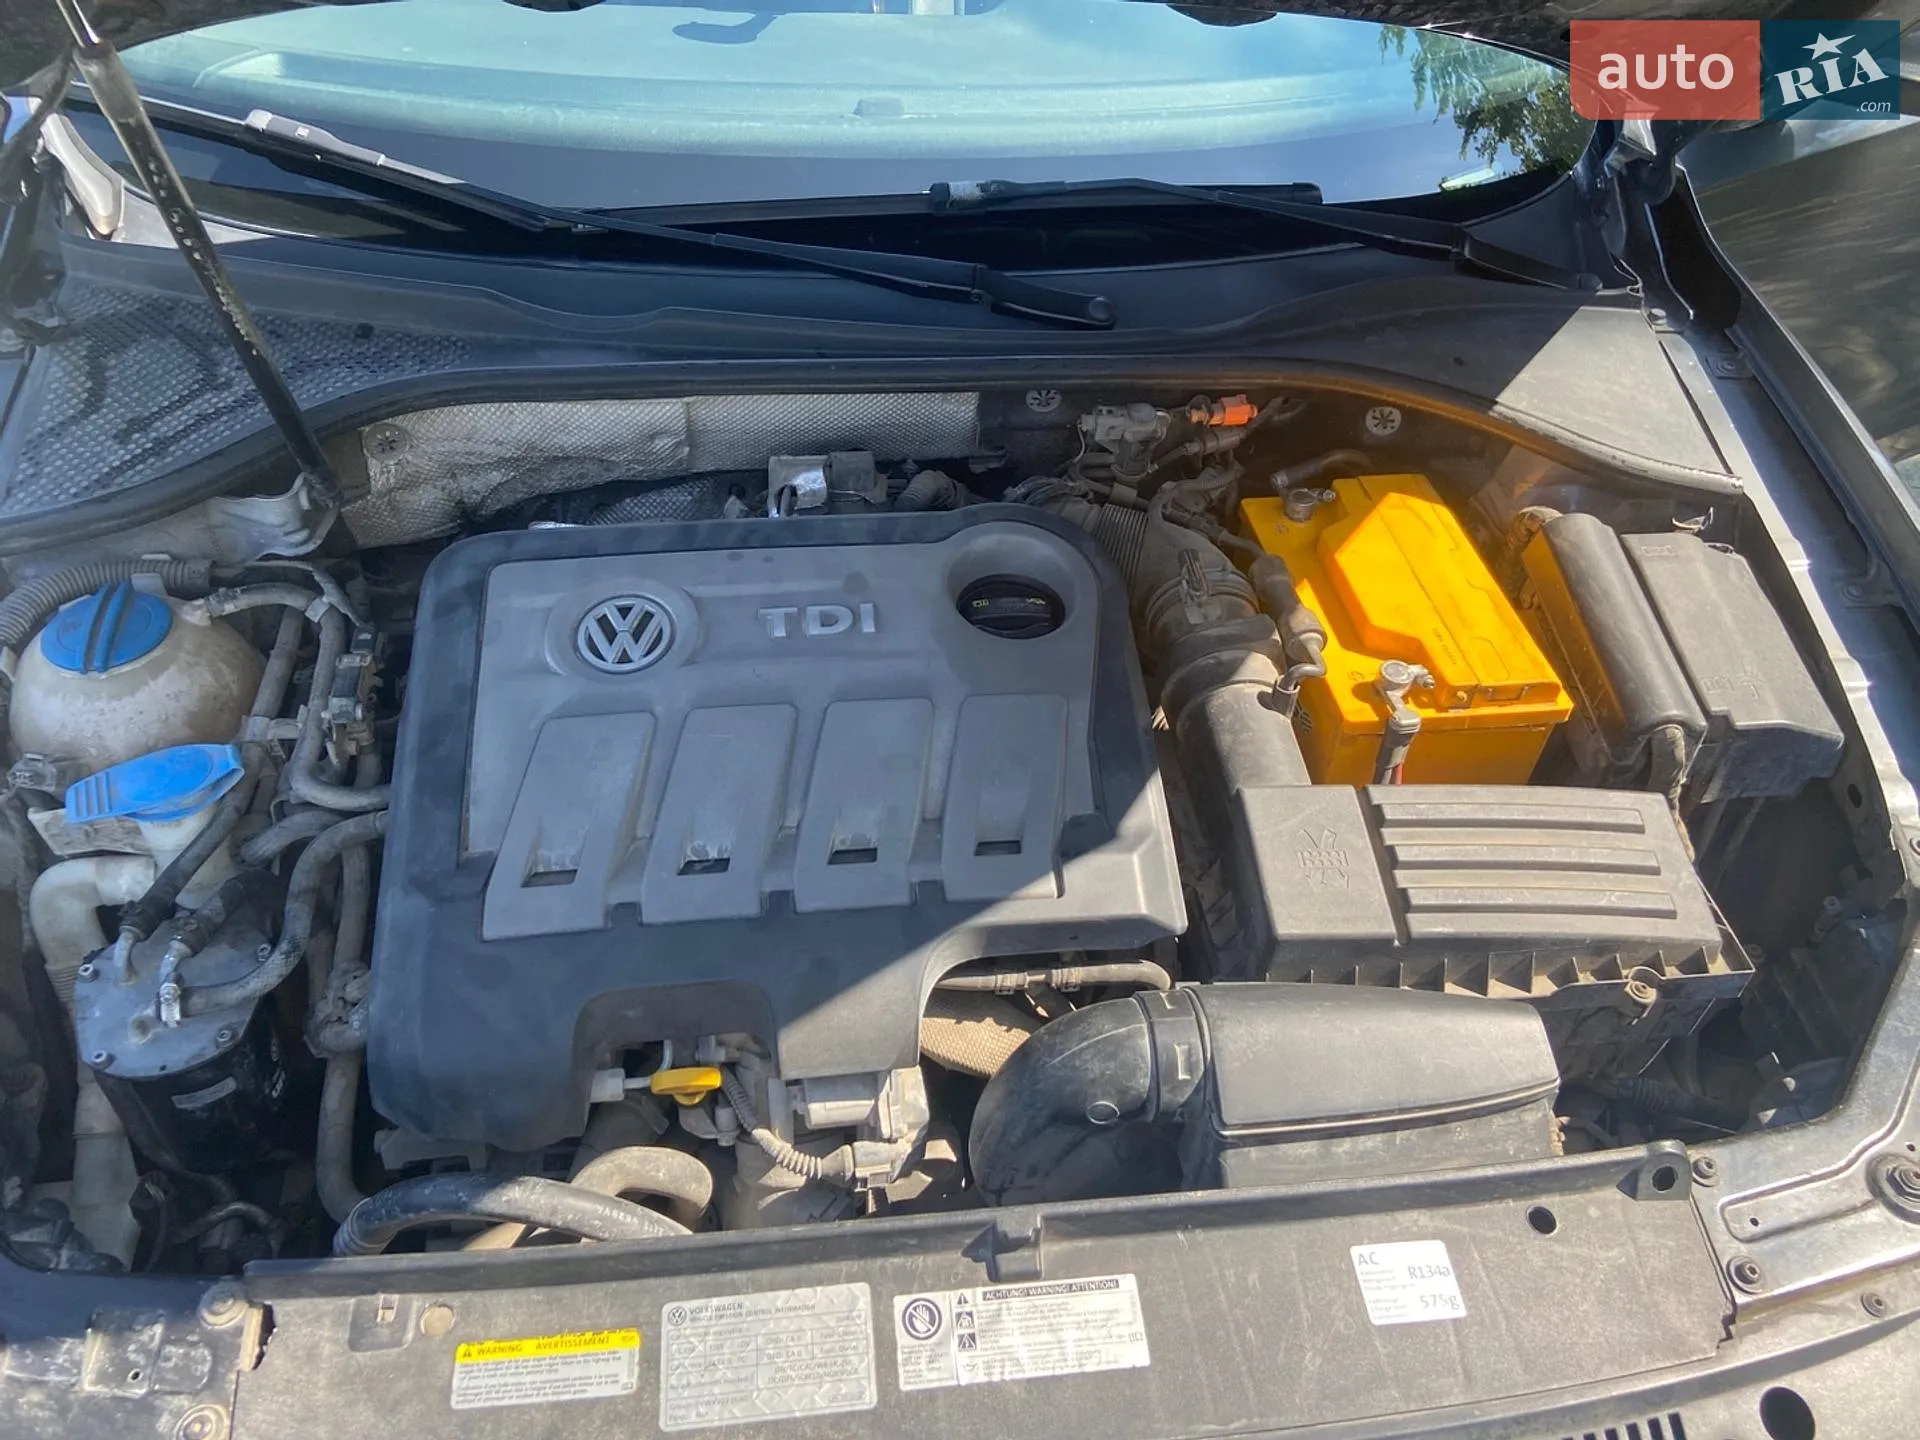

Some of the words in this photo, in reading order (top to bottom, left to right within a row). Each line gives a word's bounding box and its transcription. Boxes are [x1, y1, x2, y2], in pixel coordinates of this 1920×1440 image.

[758, 602, 877, 639] TDI
[1357, 1252, 1380, 1266] AC
[1407, 1264, 1451, 1280] R134a
[689, 1302, 743, 1315] VOLKSWAGEN
[1419, 1294, 1460, 1310] 575g
[476, 1343, 522, 1355] WARNING
[535, 1336, 611, 1351] AVERTISSEMENT
